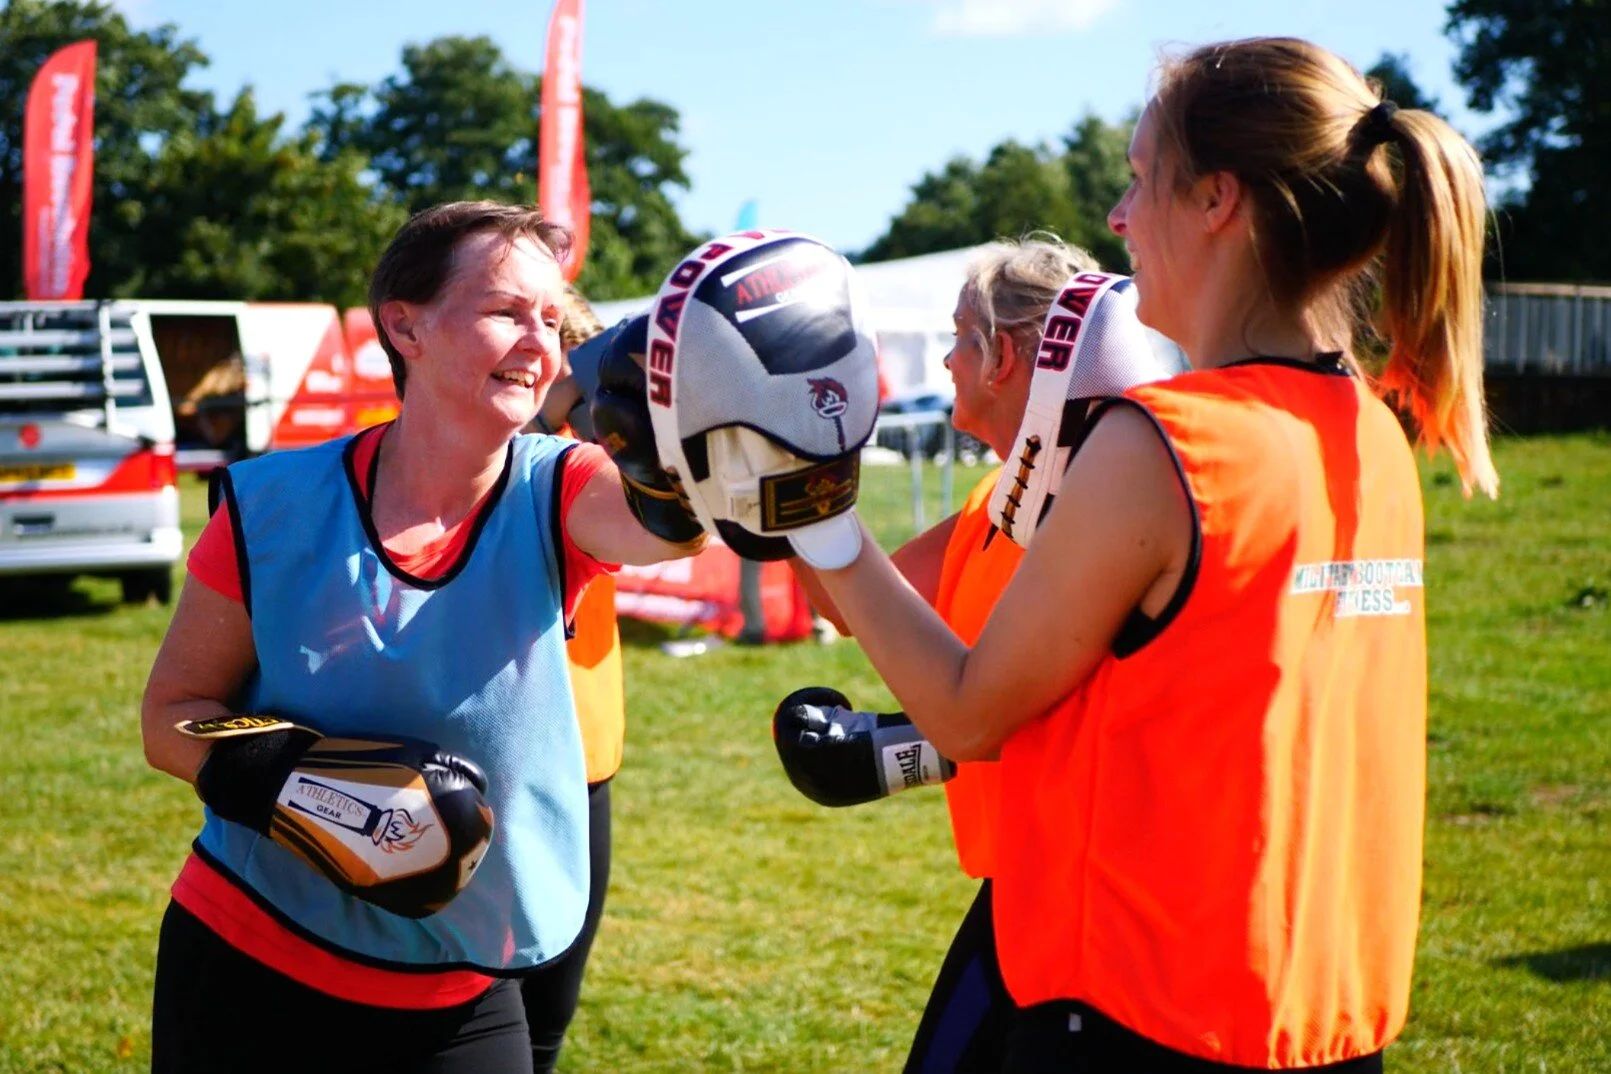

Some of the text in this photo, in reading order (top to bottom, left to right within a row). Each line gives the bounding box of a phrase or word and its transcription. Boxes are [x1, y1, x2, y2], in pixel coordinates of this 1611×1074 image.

[1036, 273, 1112, 372] OWER
[894, 749, 918, 789] DALE
[296, 783, 364, 817] ATHLETICS
[316, 804, 342, 819] GEAR
